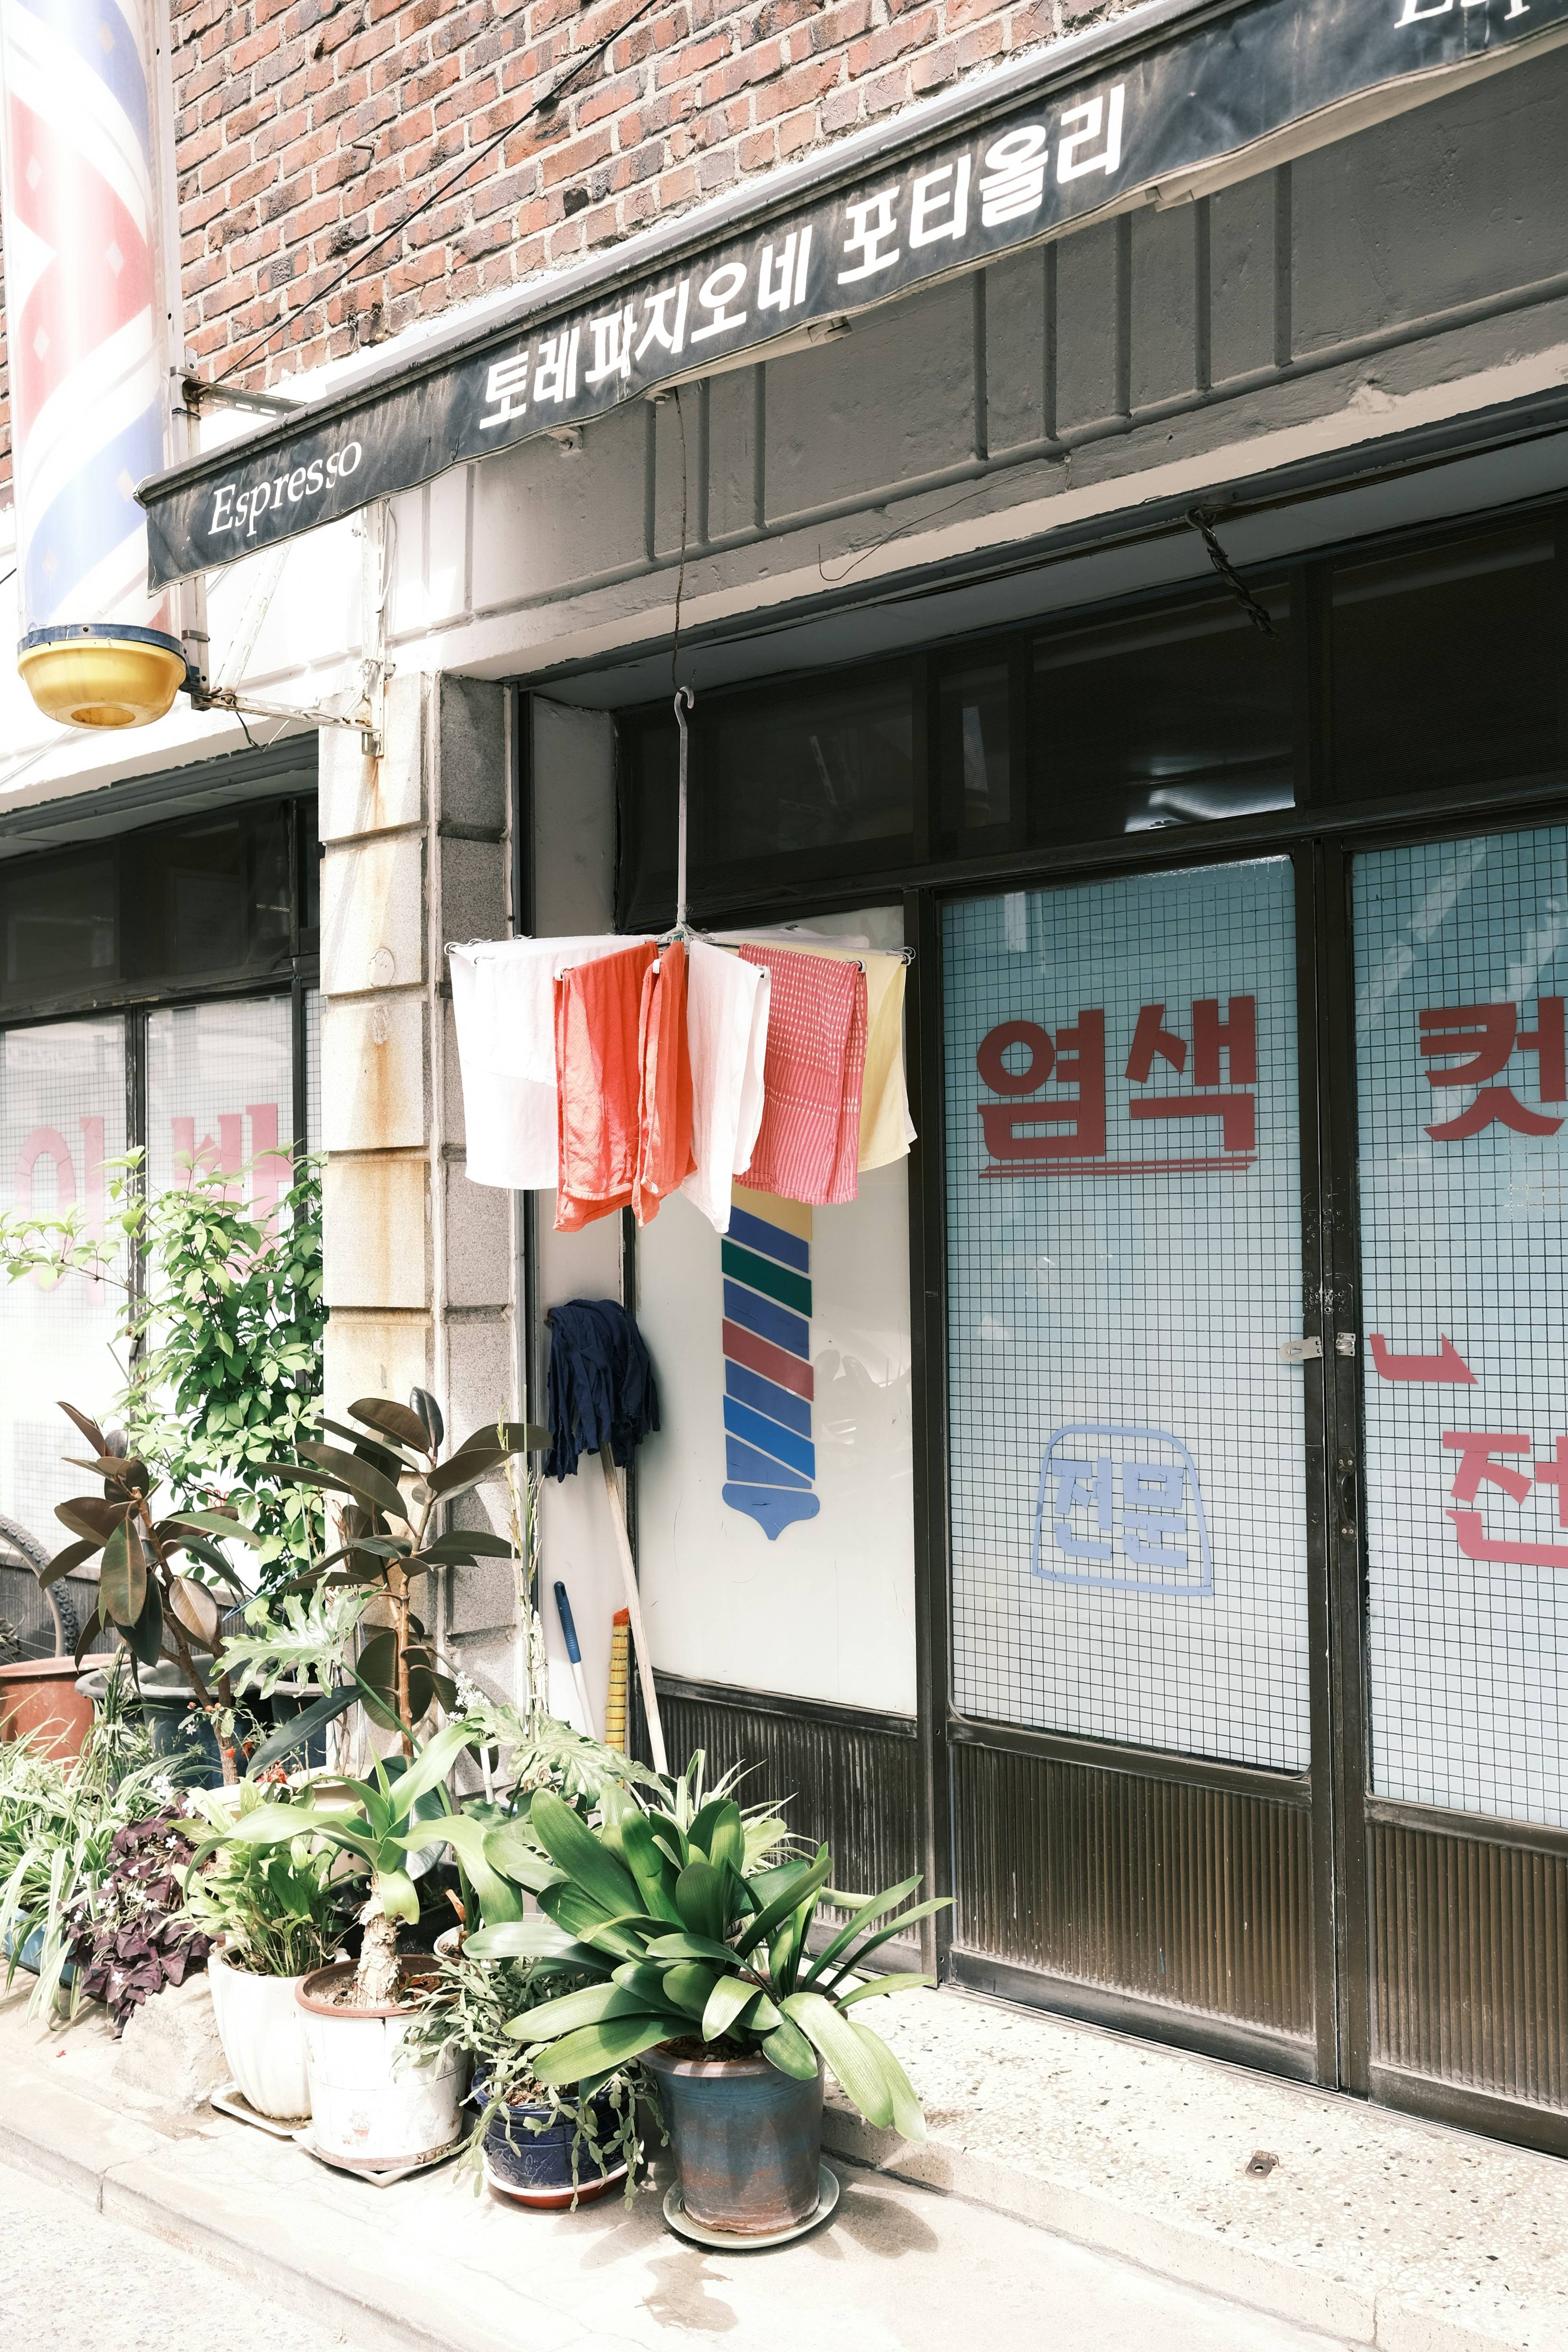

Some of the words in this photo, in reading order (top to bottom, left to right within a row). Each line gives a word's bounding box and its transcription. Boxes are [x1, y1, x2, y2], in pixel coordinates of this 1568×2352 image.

[479, 224, 813, 429] 토레파지오네
[837, 83, 1126, 285] 포티올리
[208, 441, 362, 536] Espresso
[977, 995, 1257, 1160] 염색
[1419, 997, 1567, 1141] 컷
[1051, 1457, 1188, 1569] 전문
